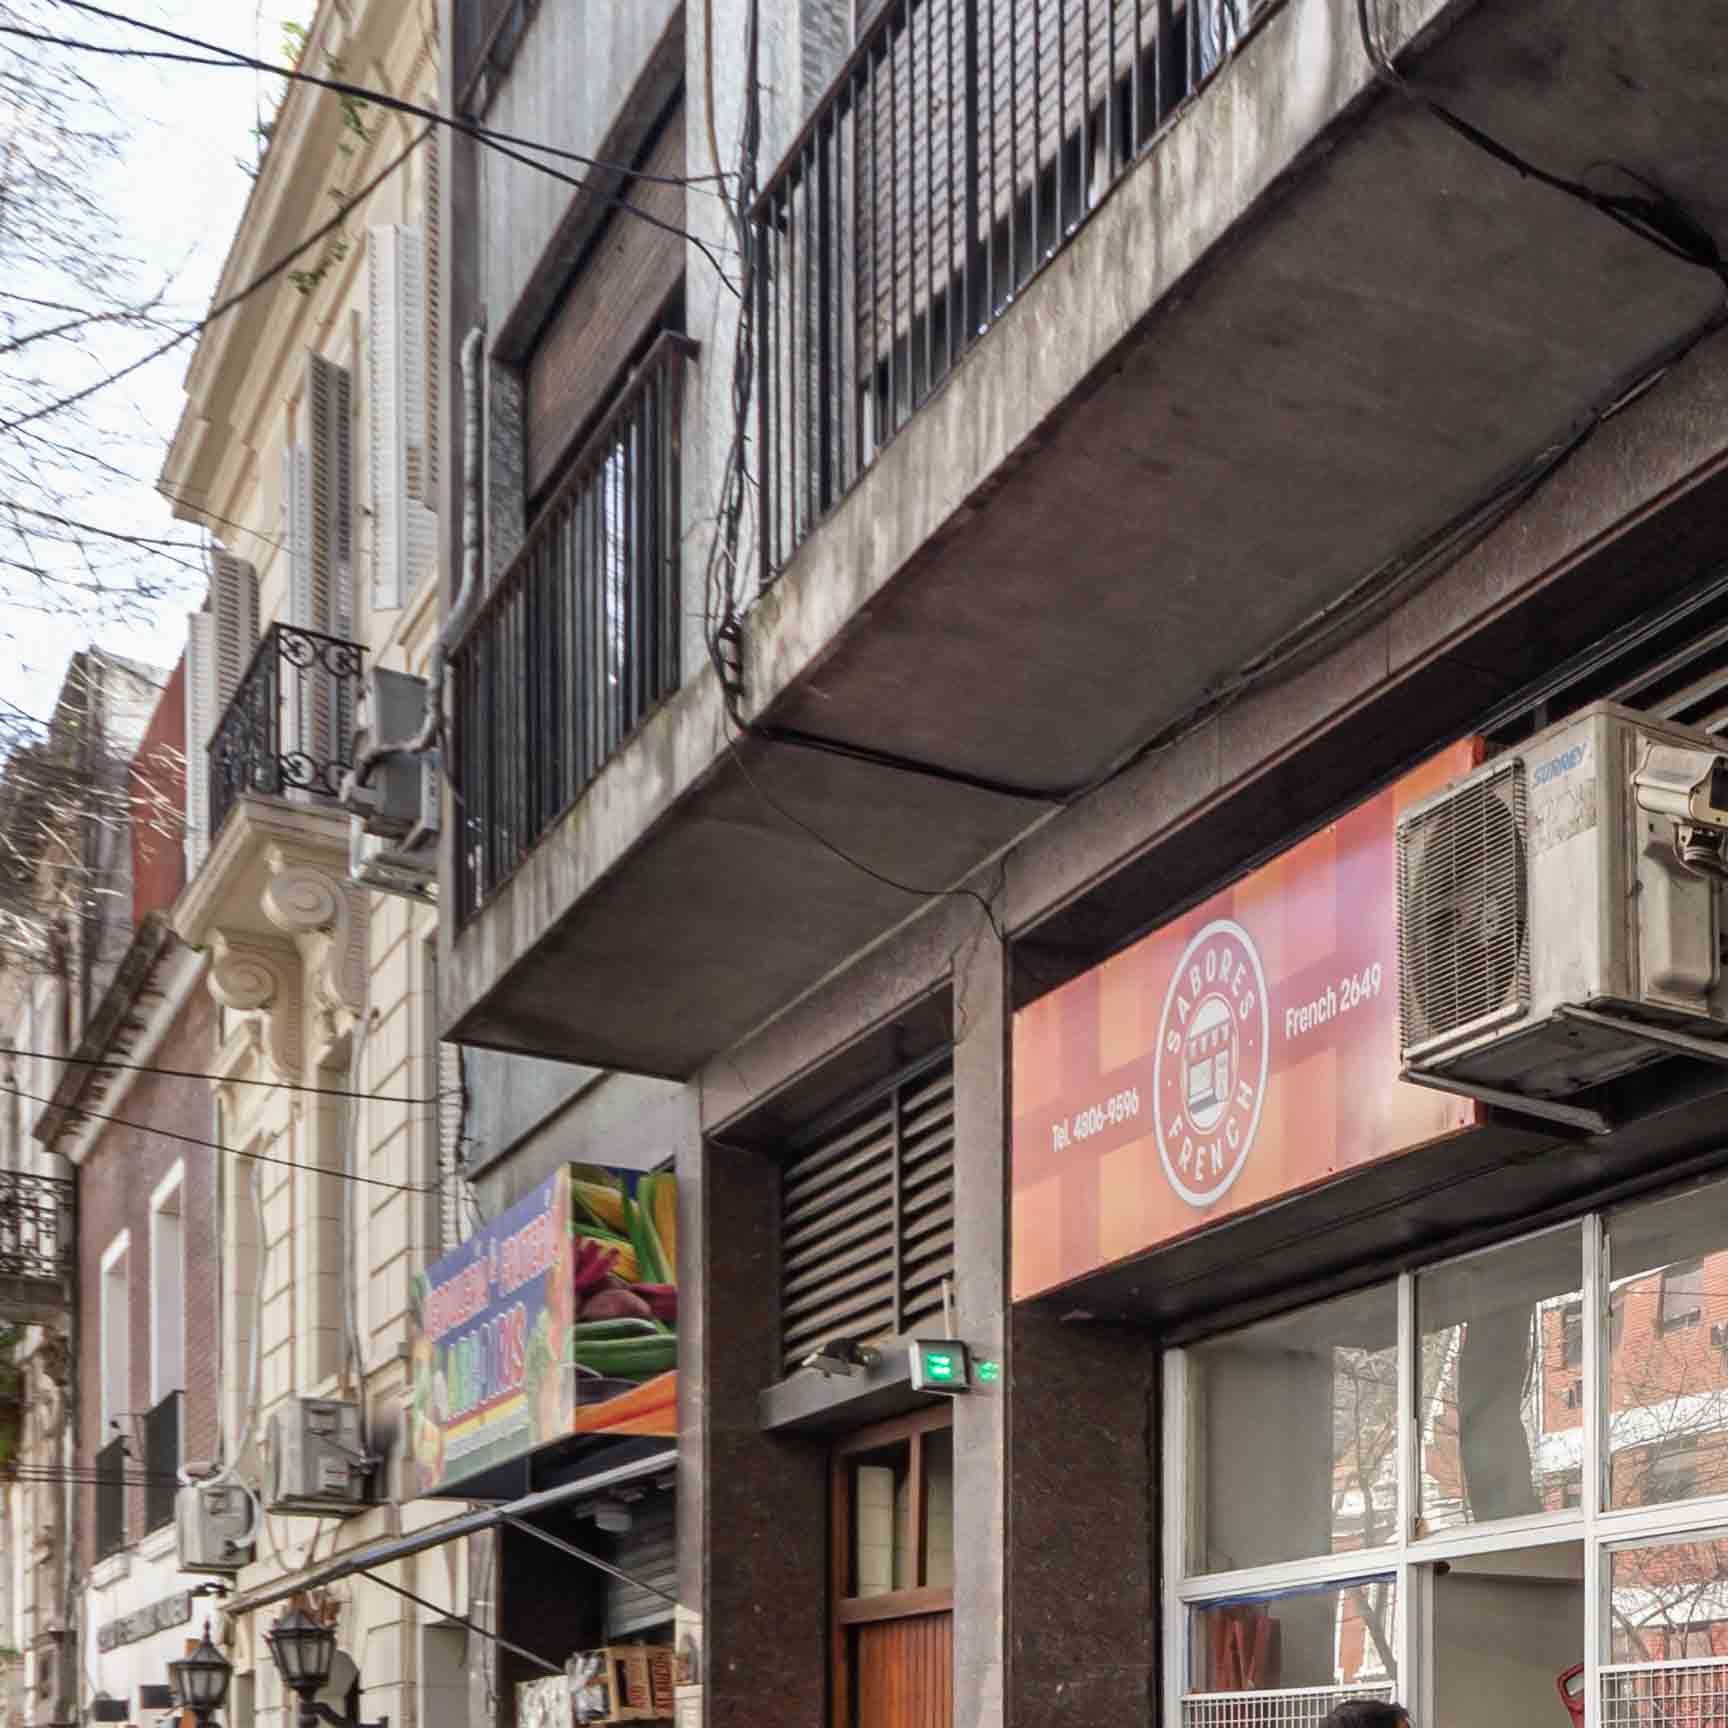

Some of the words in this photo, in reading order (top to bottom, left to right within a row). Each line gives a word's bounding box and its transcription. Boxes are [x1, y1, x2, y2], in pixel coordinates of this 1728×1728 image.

[1167, 948, 1255, 1053] SABORES
[1285, 984, 1338, 1041] French
[1340, 961, 1382, 1012] 2649
[1168, 1079, 1252, 1182] FRENCH
